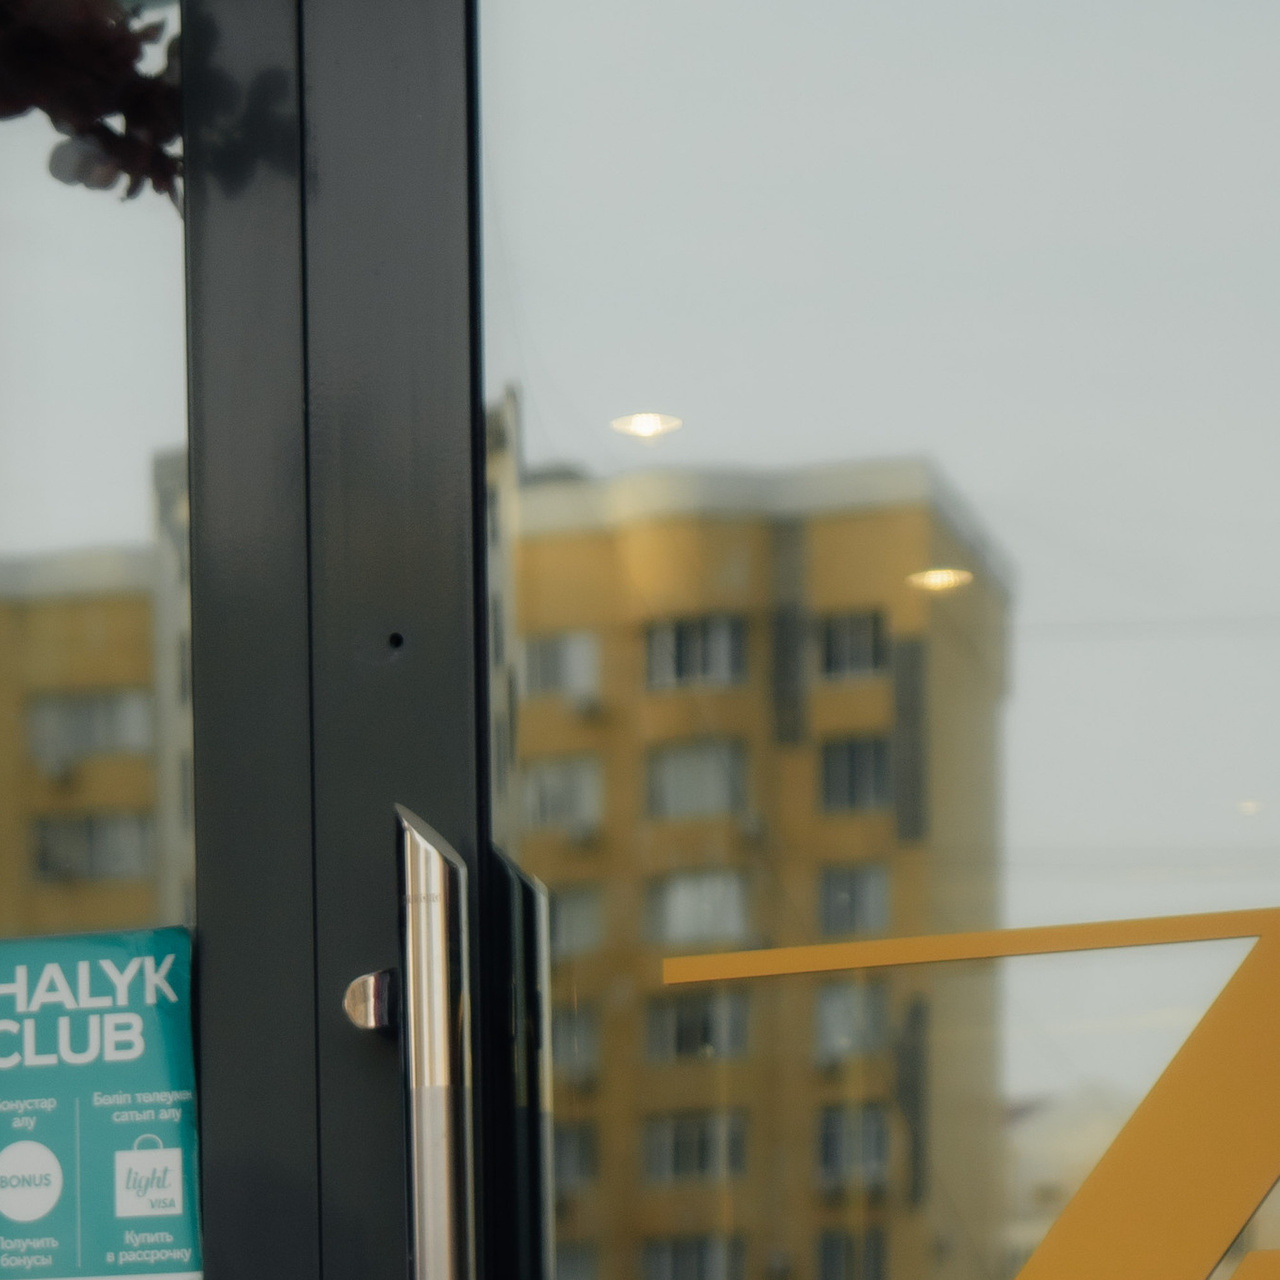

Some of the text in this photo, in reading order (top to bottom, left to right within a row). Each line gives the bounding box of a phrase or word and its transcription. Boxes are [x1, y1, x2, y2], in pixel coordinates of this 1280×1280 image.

[12, 1115, 37, 1130] алу
[0, 1174, 52, 1189] BONUS
[125, 1166, 172, 1198] light
[149, 1198, 176, 1209] VISA
[124, 1230, 174, 1247] Купить
[0, 1254, 53, 1269] бонусы
[119, 1246, 192, 1265] рассрочку
